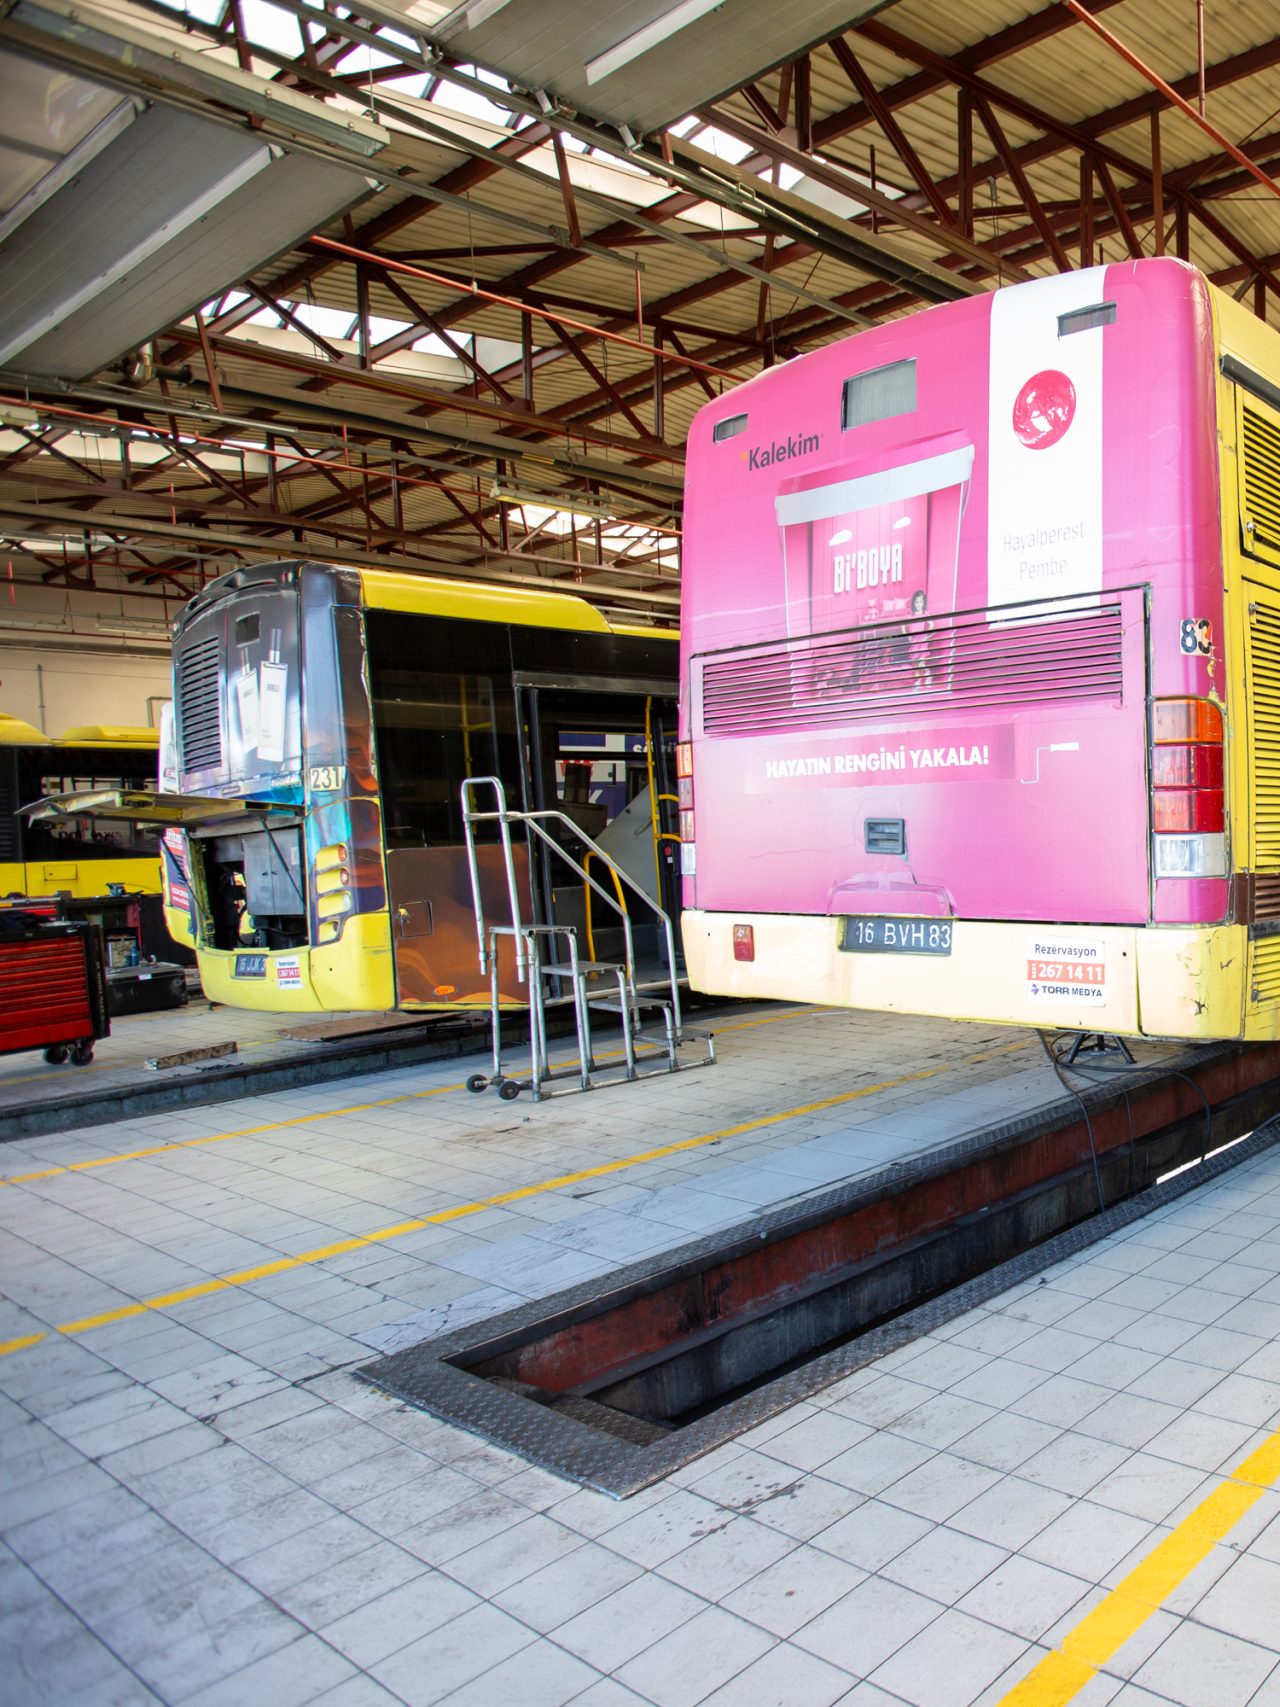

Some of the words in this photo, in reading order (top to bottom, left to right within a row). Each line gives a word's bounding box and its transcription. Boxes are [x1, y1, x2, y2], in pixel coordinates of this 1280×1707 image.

[748, 433, 819, 472] Kalekim
[1003, 519, 1085, 553] Hayalperest
[1020, 556, 1067, 581] Pembe
[766, 756, 832, 779] HAYATIN
[834, 746, 906, 774] RENGİNİ
[908, 745, 989, 769] YAKALA!
[312, 767, 340, 789] 231
[858, 922, 874, 944] 16
[884, 923, 925, 947] BVH
[929, 925, 951, 948] 83
[1034, 943, 1097, 958] Rezervasyon
[1038, 963, 1064, 978] 267
[1066, 965, 1084, 980] 14
[1086, 966, 1102, 982] 11
[1041, 985, 1070, 995] TORR
[1072, 987, 1102, 997] MEDYA
